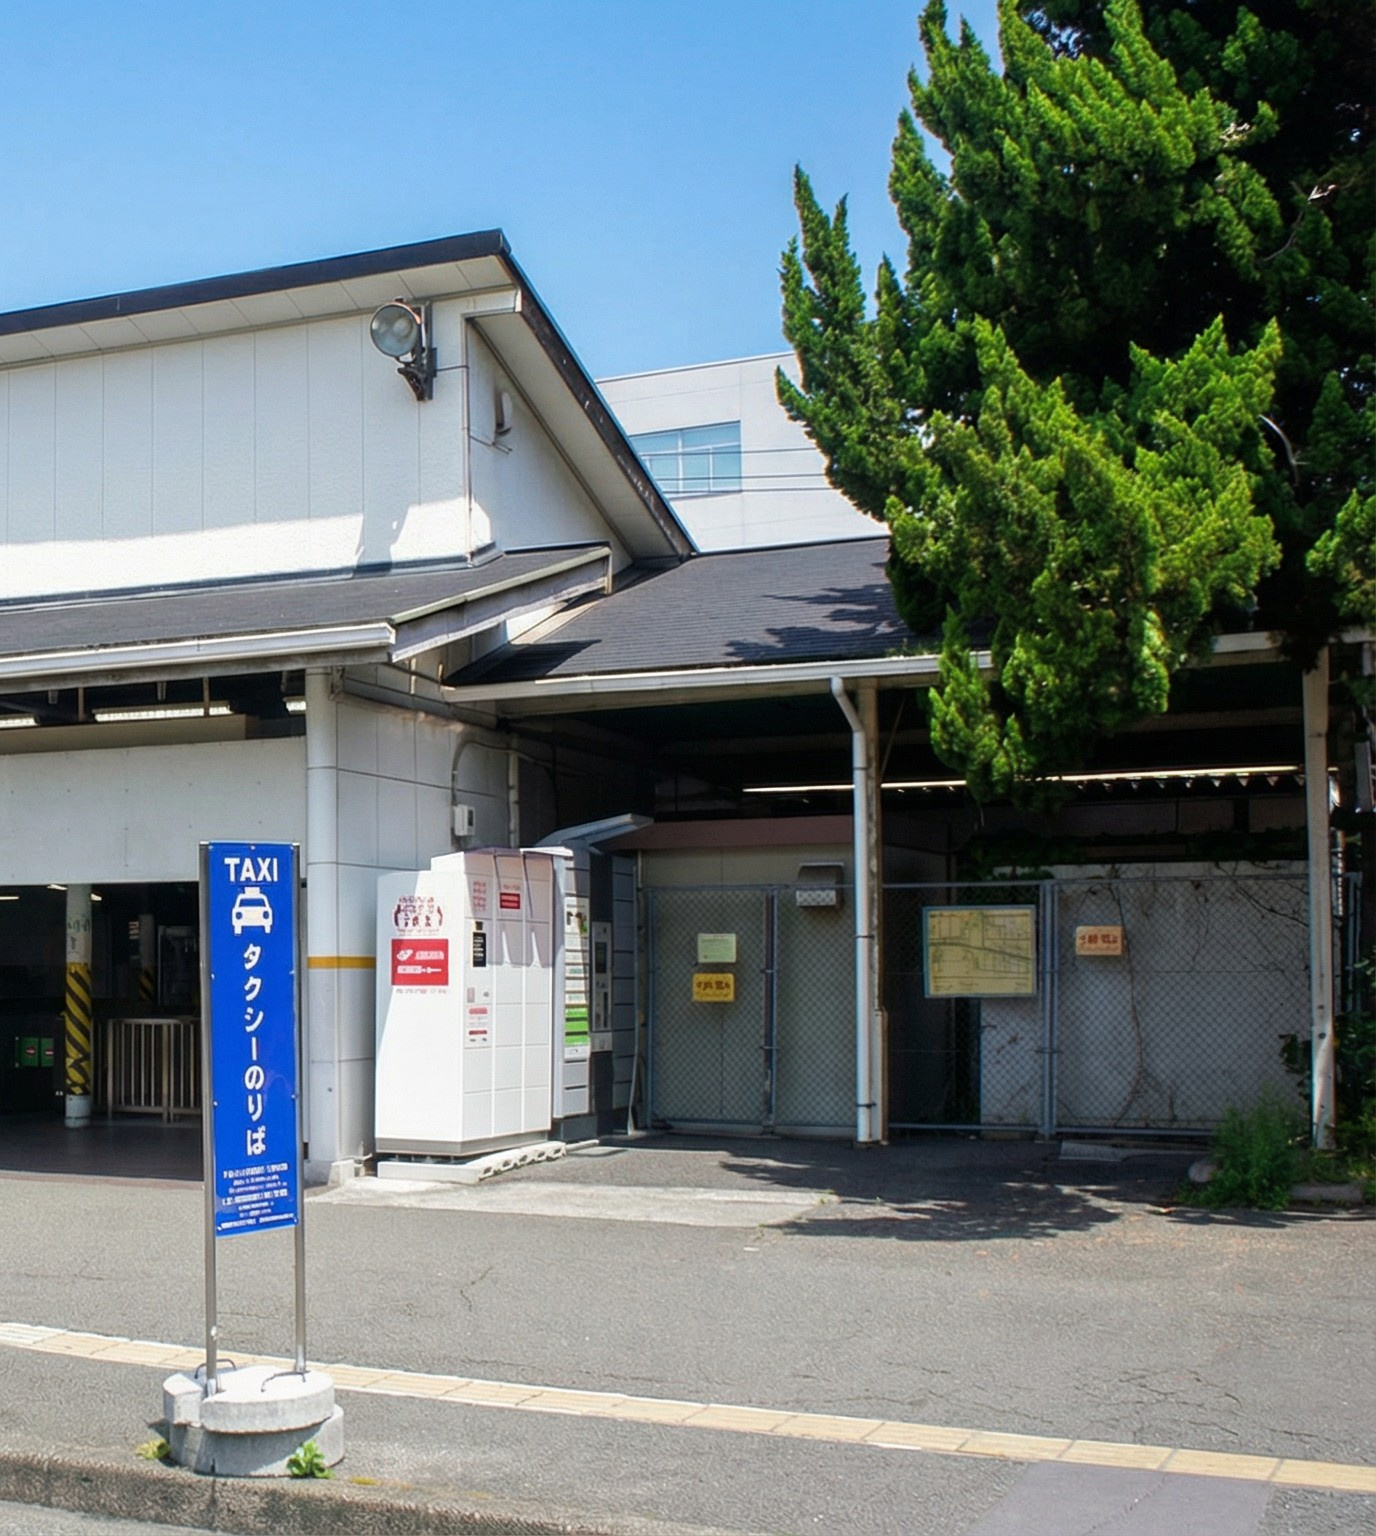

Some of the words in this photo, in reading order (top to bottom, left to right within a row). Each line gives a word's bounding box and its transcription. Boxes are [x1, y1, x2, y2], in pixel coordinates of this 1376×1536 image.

[224, 857, 279, 883] TAXI
[243, 944, 266, 1155] タクシーのりば
